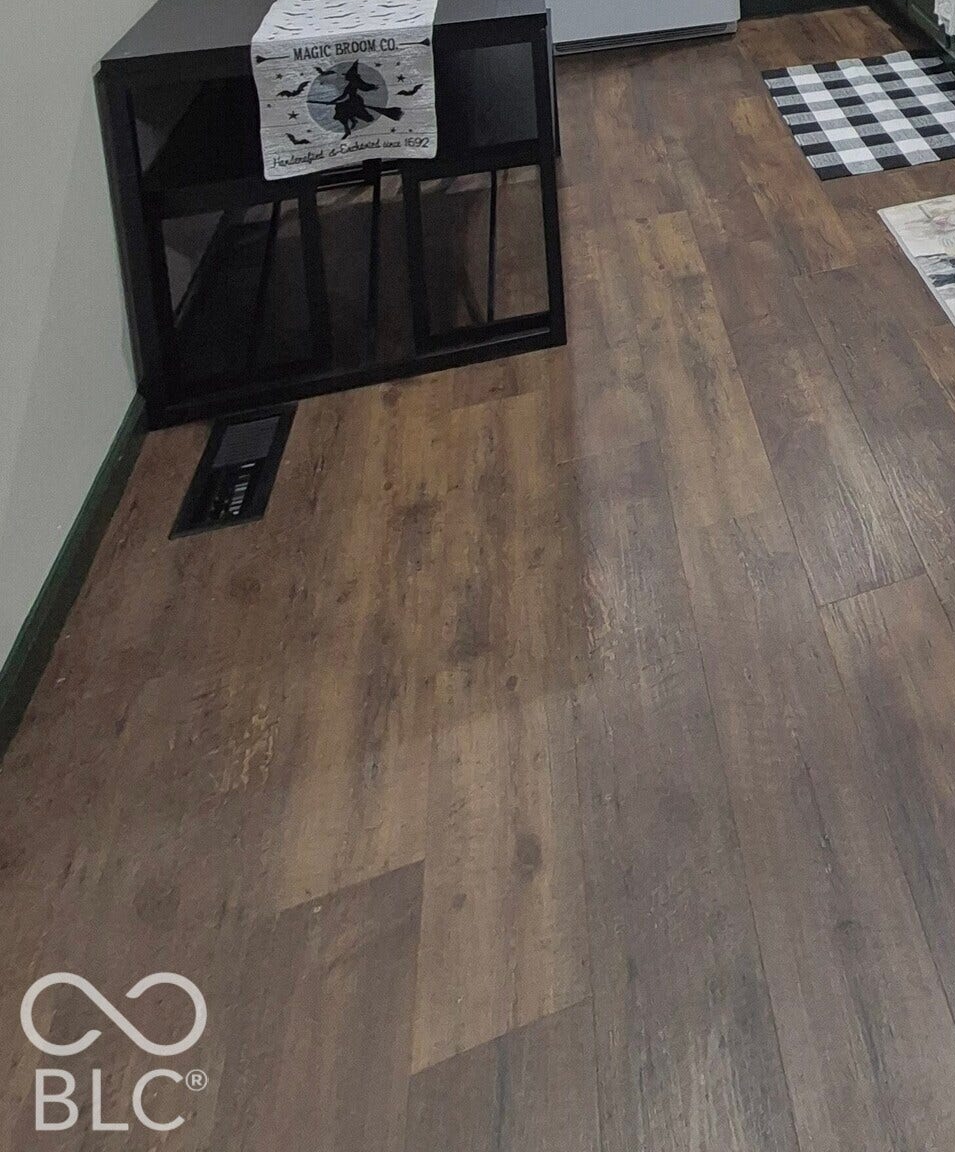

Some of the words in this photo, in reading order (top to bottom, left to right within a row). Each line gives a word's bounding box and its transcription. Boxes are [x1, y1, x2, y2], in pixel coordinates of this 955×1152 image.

[293, 45, 331, 61] MAGIC
[335, 40, 376, 56] BROOM
[380, 38, 398, 52] CO.
[404, 137, 430, 148] 1692
